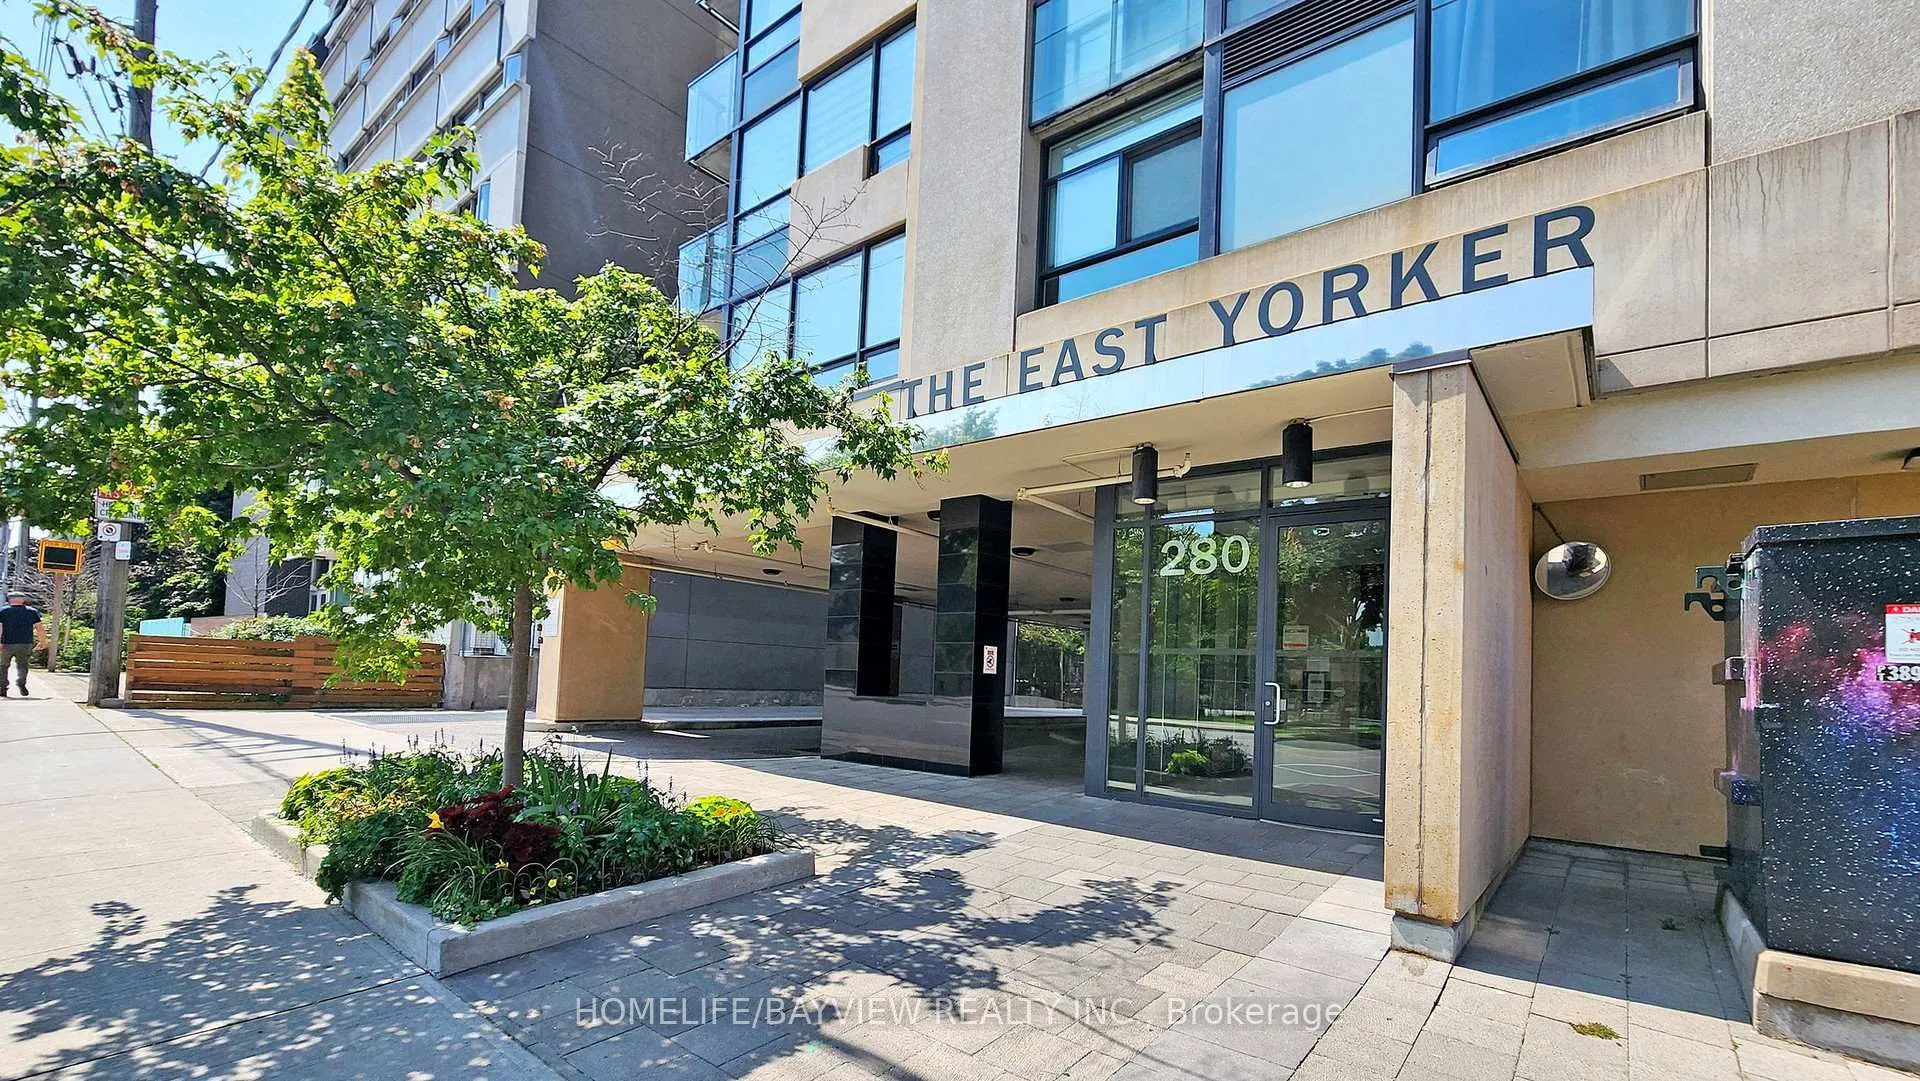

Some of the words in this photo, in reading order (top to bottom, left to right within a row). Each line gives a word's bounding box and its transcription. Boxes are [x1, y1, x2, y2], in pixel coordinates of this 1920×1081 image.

[904, 361, 986, 419] THE
[1018, 314, 1167, 394] EAST
[1208, 205, 1596, 347] YORKER
[1160, 534, 1250, 576] 280
[1887, 665, 1920, 681] 389
